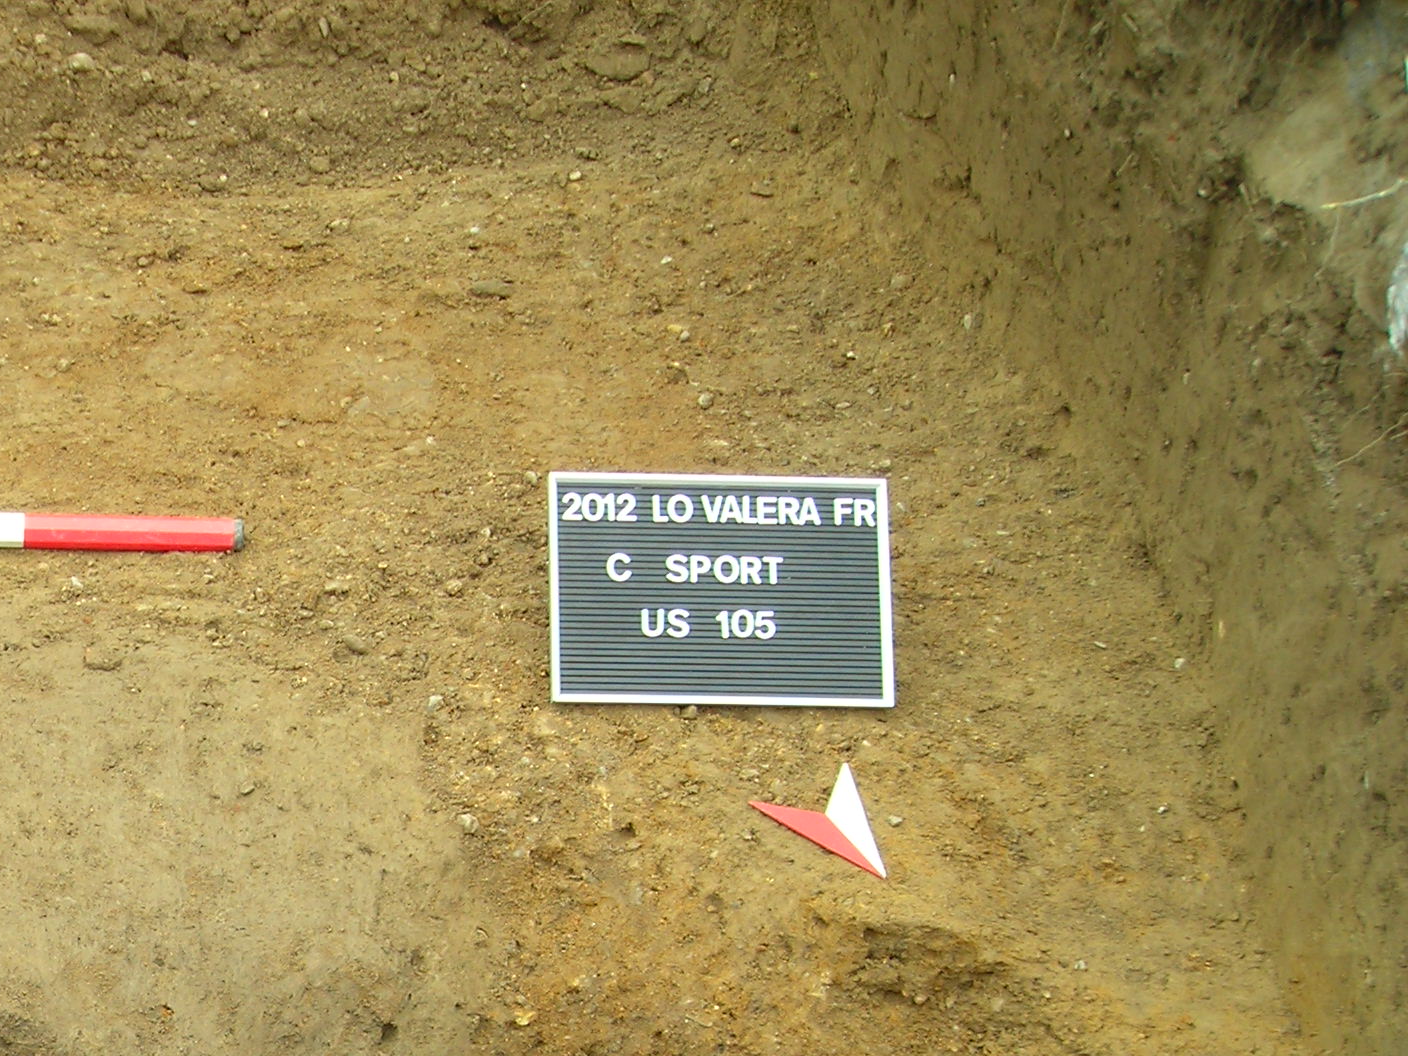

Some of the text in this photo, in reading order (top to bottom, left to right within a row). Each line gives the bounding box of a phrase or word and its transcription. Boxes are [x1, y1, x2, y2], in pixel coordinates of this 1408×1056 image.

[561, 492, 876, 527] 2012 LO VALERA FR
[606, 552, 783, 584] C SPORT
[640, 608, 776, 640] US 105
